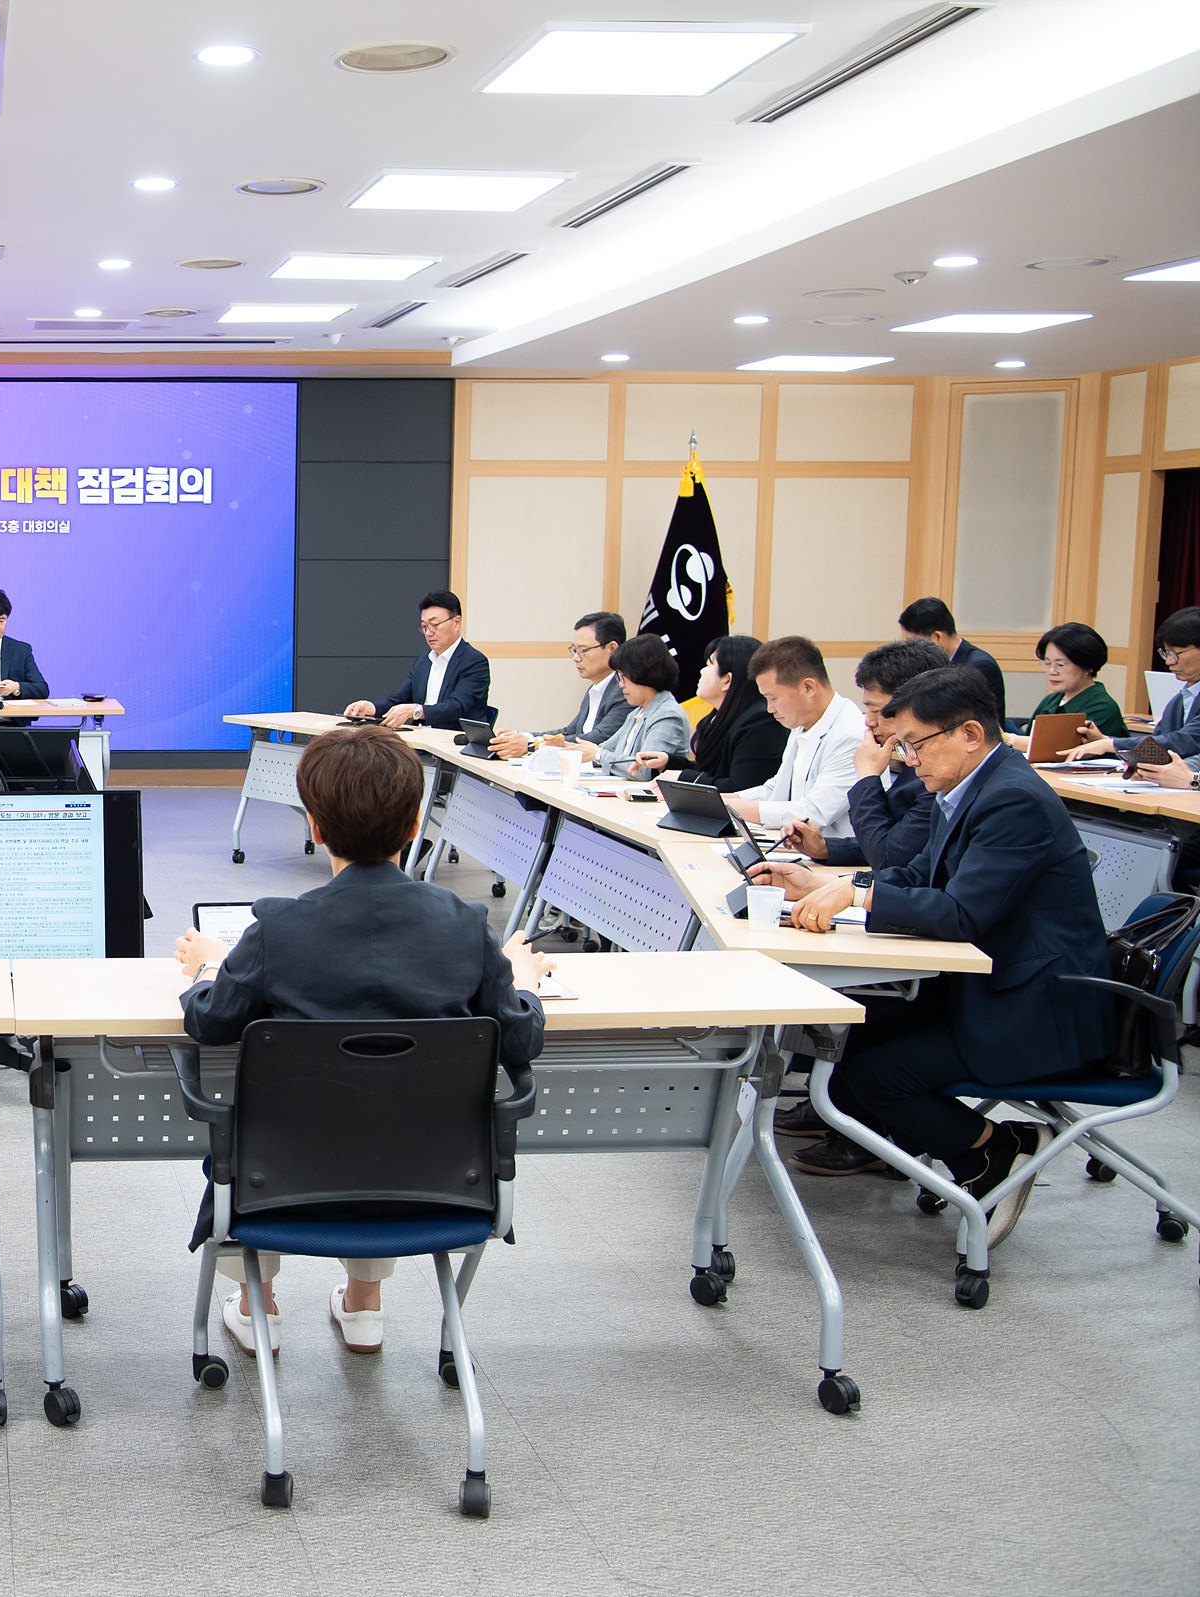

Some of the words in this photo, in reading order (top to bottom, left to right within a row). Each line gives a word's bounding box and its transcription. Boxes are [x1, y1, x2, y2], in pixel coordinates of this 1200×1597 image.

[0, 466, 68, 505] 대책
[77, 465, 212, 505] 점검회의
[22, 519, 71, 534] 대회의실
